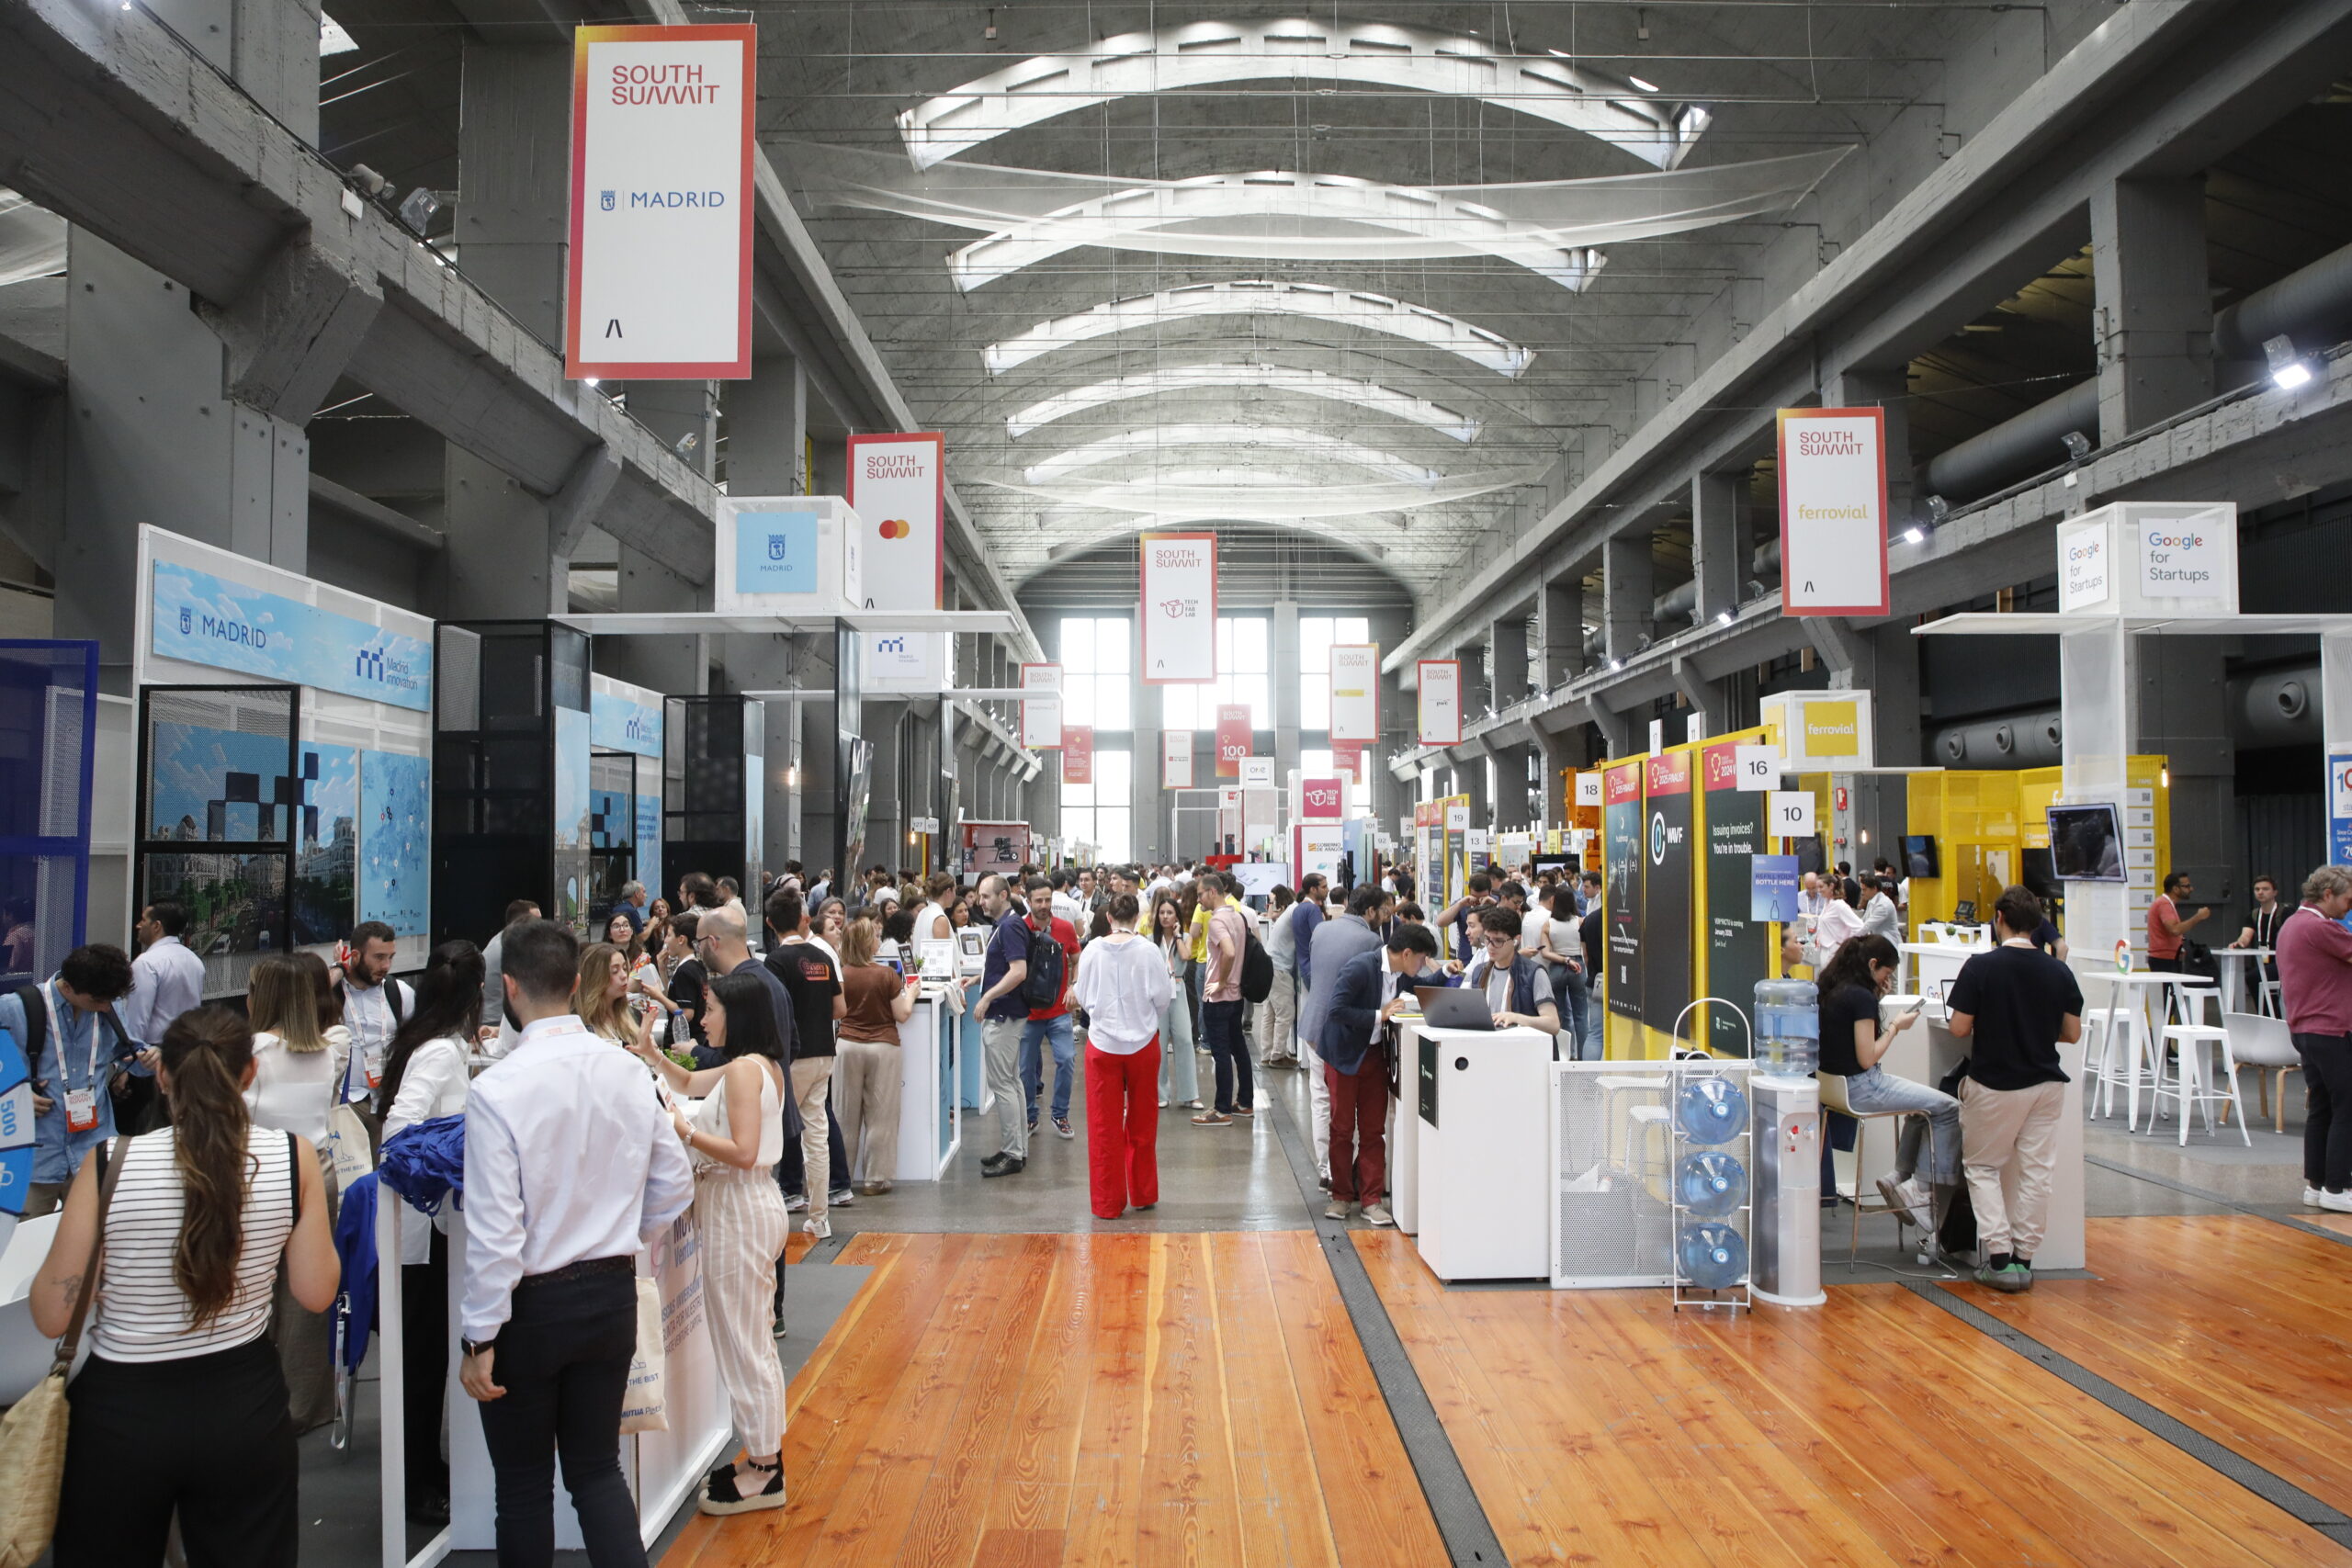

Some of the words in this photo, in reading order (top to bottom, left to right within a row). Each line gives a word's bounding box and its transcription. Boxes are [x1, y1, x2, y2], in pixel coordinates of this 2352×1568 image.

[611, 64, 704, 85] SOUTH
[611, 85, 721, 106] SUMMIT
[631, 191, 725, 209] MADRID
[1800, 431, 1854, 444] SOUTH
[1800, 443, 1864, 456] SUMMIT
[866, 455, 916, 468] SOUTH
[866, 467, 925, 479] SUMMIT
[1797, 503, 1869, 520] ferrovial
[2148, 532, 2203, 550] Google
[1156, 549, 1195, 558] SOUTH
[2069, 540, 2100, 561] Google
[2149, 550, 2170, 563] for
[760, 564, 793, 572] MADRID
[1156, 558, 1203, 568] SUMMIT
[2069, 563, 2082, 578] for
[2149, 567, 2210, 583] Startups
[2069, 573, 2103, 595] Startups
[202, 615, 267, 649] MADRID
[386, 656, 410, 675] Madrid
[1807, 723, 1855, 735] ferrovial
[1222, 745, 1247, 756] 100
[1748, 761, 1769, 775] 16
[1668, 772, 1685, 784] FINALIST
[1584, 784, 1598, 795] 18
[1623, 782, 1635, 793] FINALIST
[1453, 814, 1464, 823] 19
[1782, 807, 1803, 821] 10
[1406, 823, 1414, 831] 21
[1713, 824, 1730, 839] Issuing
[1729, 821, 1754, 835] invoices?
[1470, 837, 1480, 845] 13
[1713, 842, 1728, 855] You're
[1728, 841, 1734, 854] in
[1734, 840, 1754, 854] trouble.
[628, 1375, 642, 1386] THE
